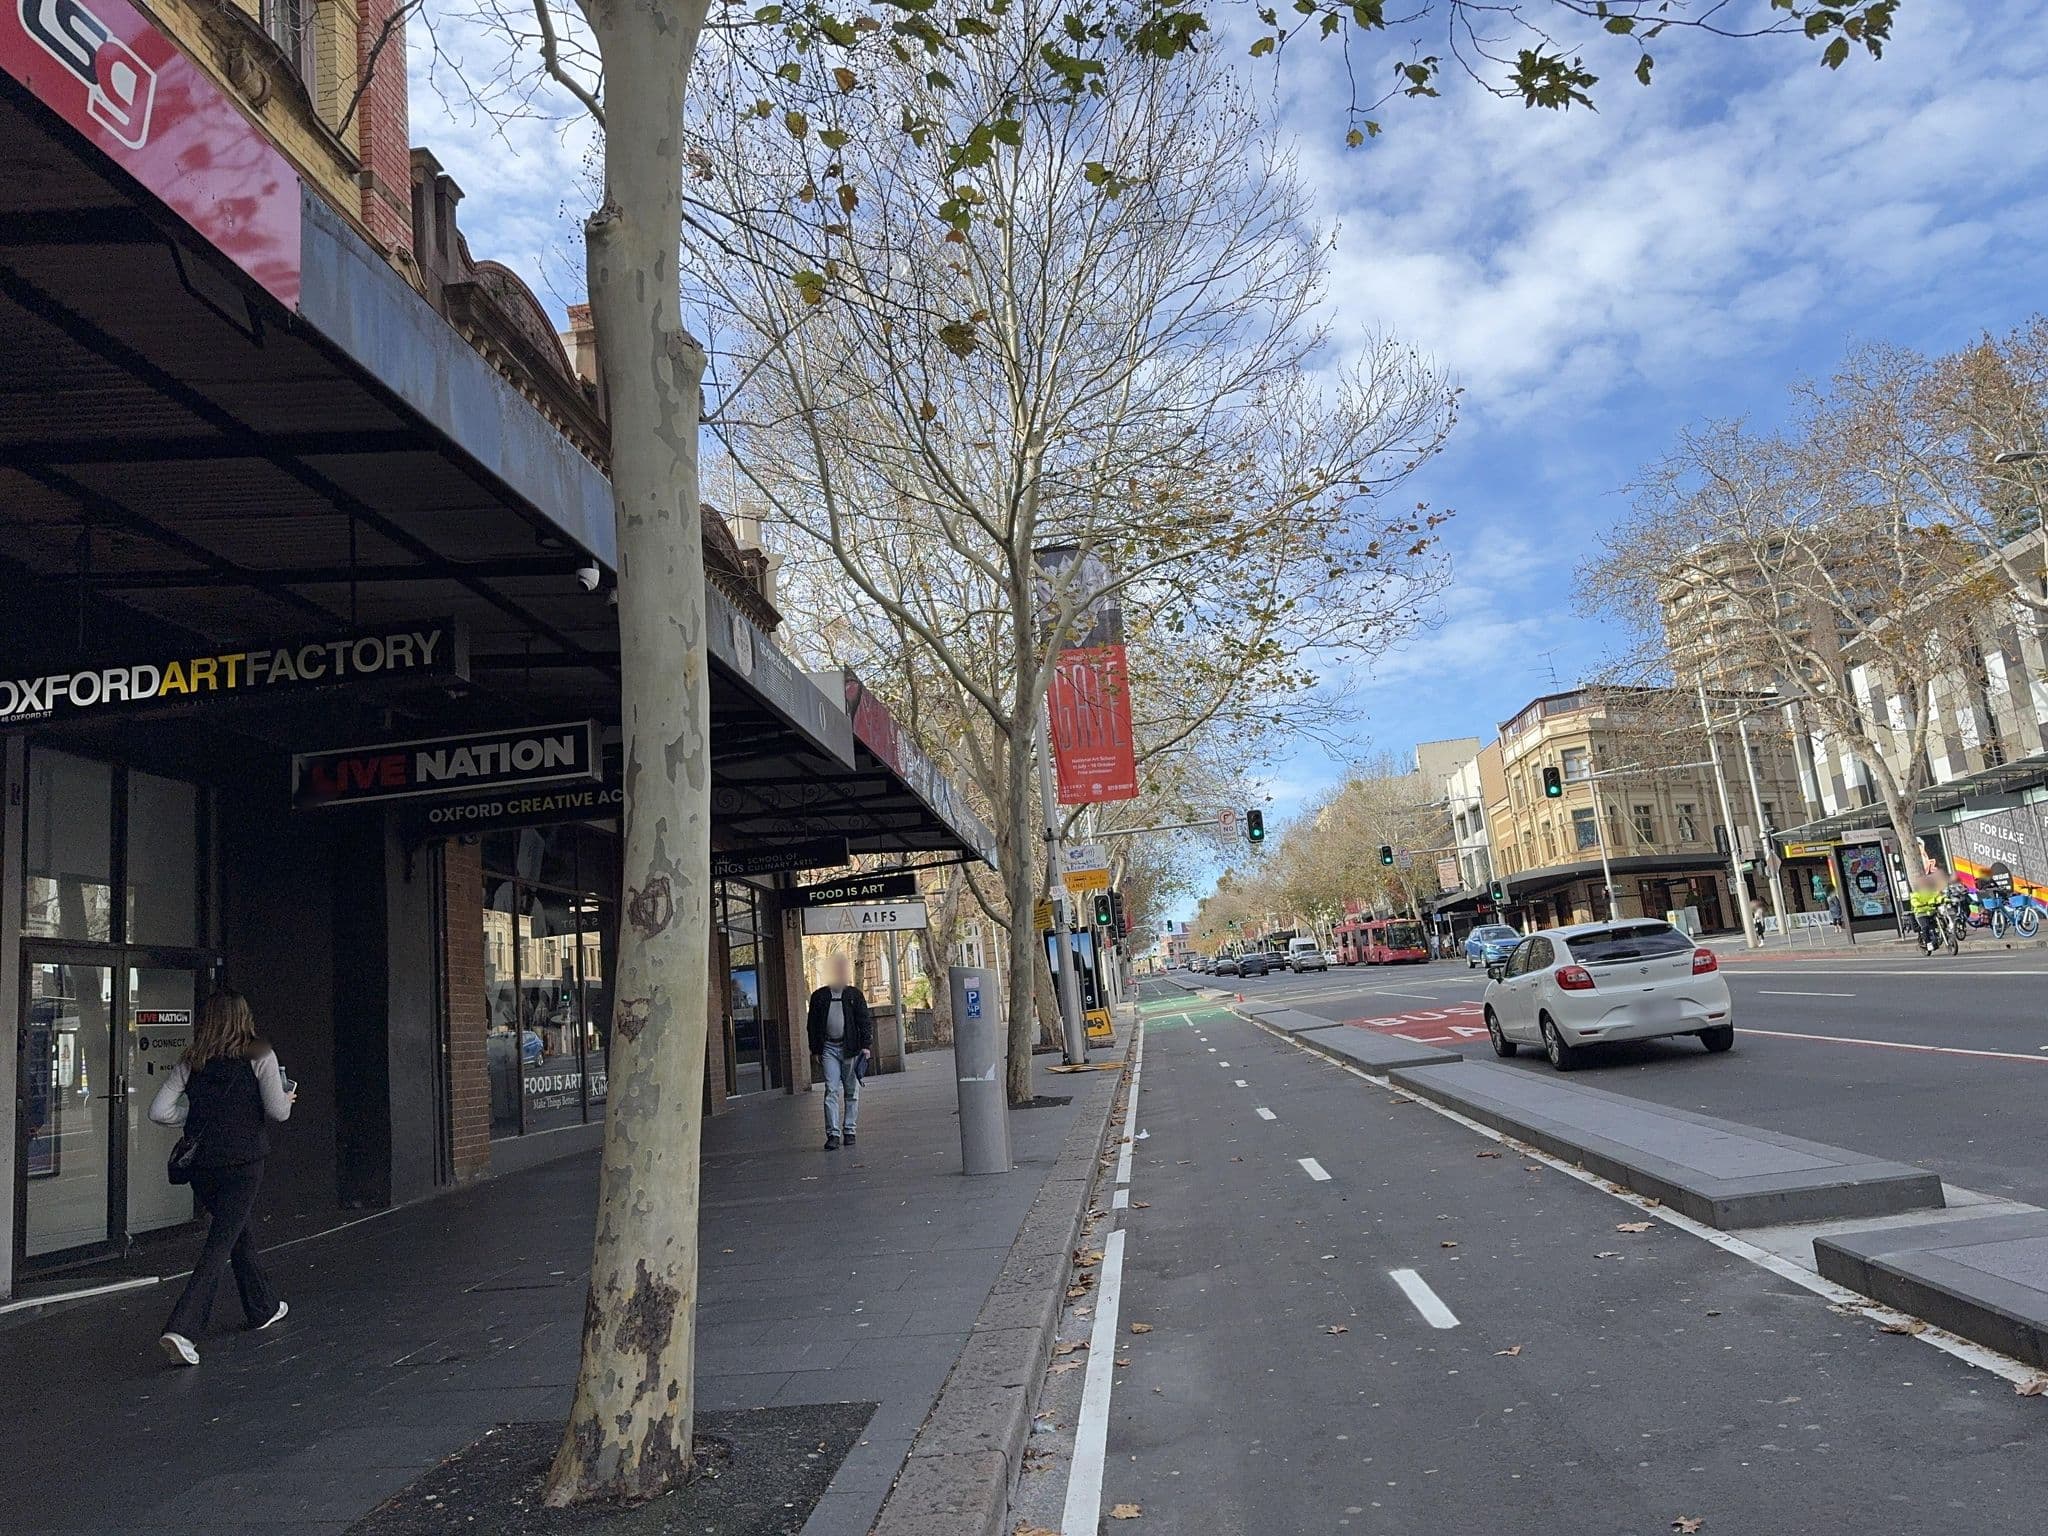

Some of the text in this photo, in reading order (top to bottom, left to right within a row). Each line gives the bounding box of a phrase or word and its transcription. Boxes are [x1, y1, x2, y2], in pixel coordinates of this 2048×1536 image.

[10, 711, 41, 722] OXFORD
[43, 710, 52, 718] ST
[311, 735, 575, 792] LIVE NATION
[429, 803, 503, 822] OXFORD
[507, 793, 593, 816] CREATIVE
[1979, 822, 2025, 845] FOR LEASE
[1973, 842, 2018, 865] FOR LEASE
[809, 883, 885, 902] FOOD IS ART
[862, 911, 897, 923] AIFS
[139, 1013, 187, 1022] LIVE NATION
[1364, 1007, 1484, 1026] BUS
[523, 1073, 582, 1095] FOOD IS ART
